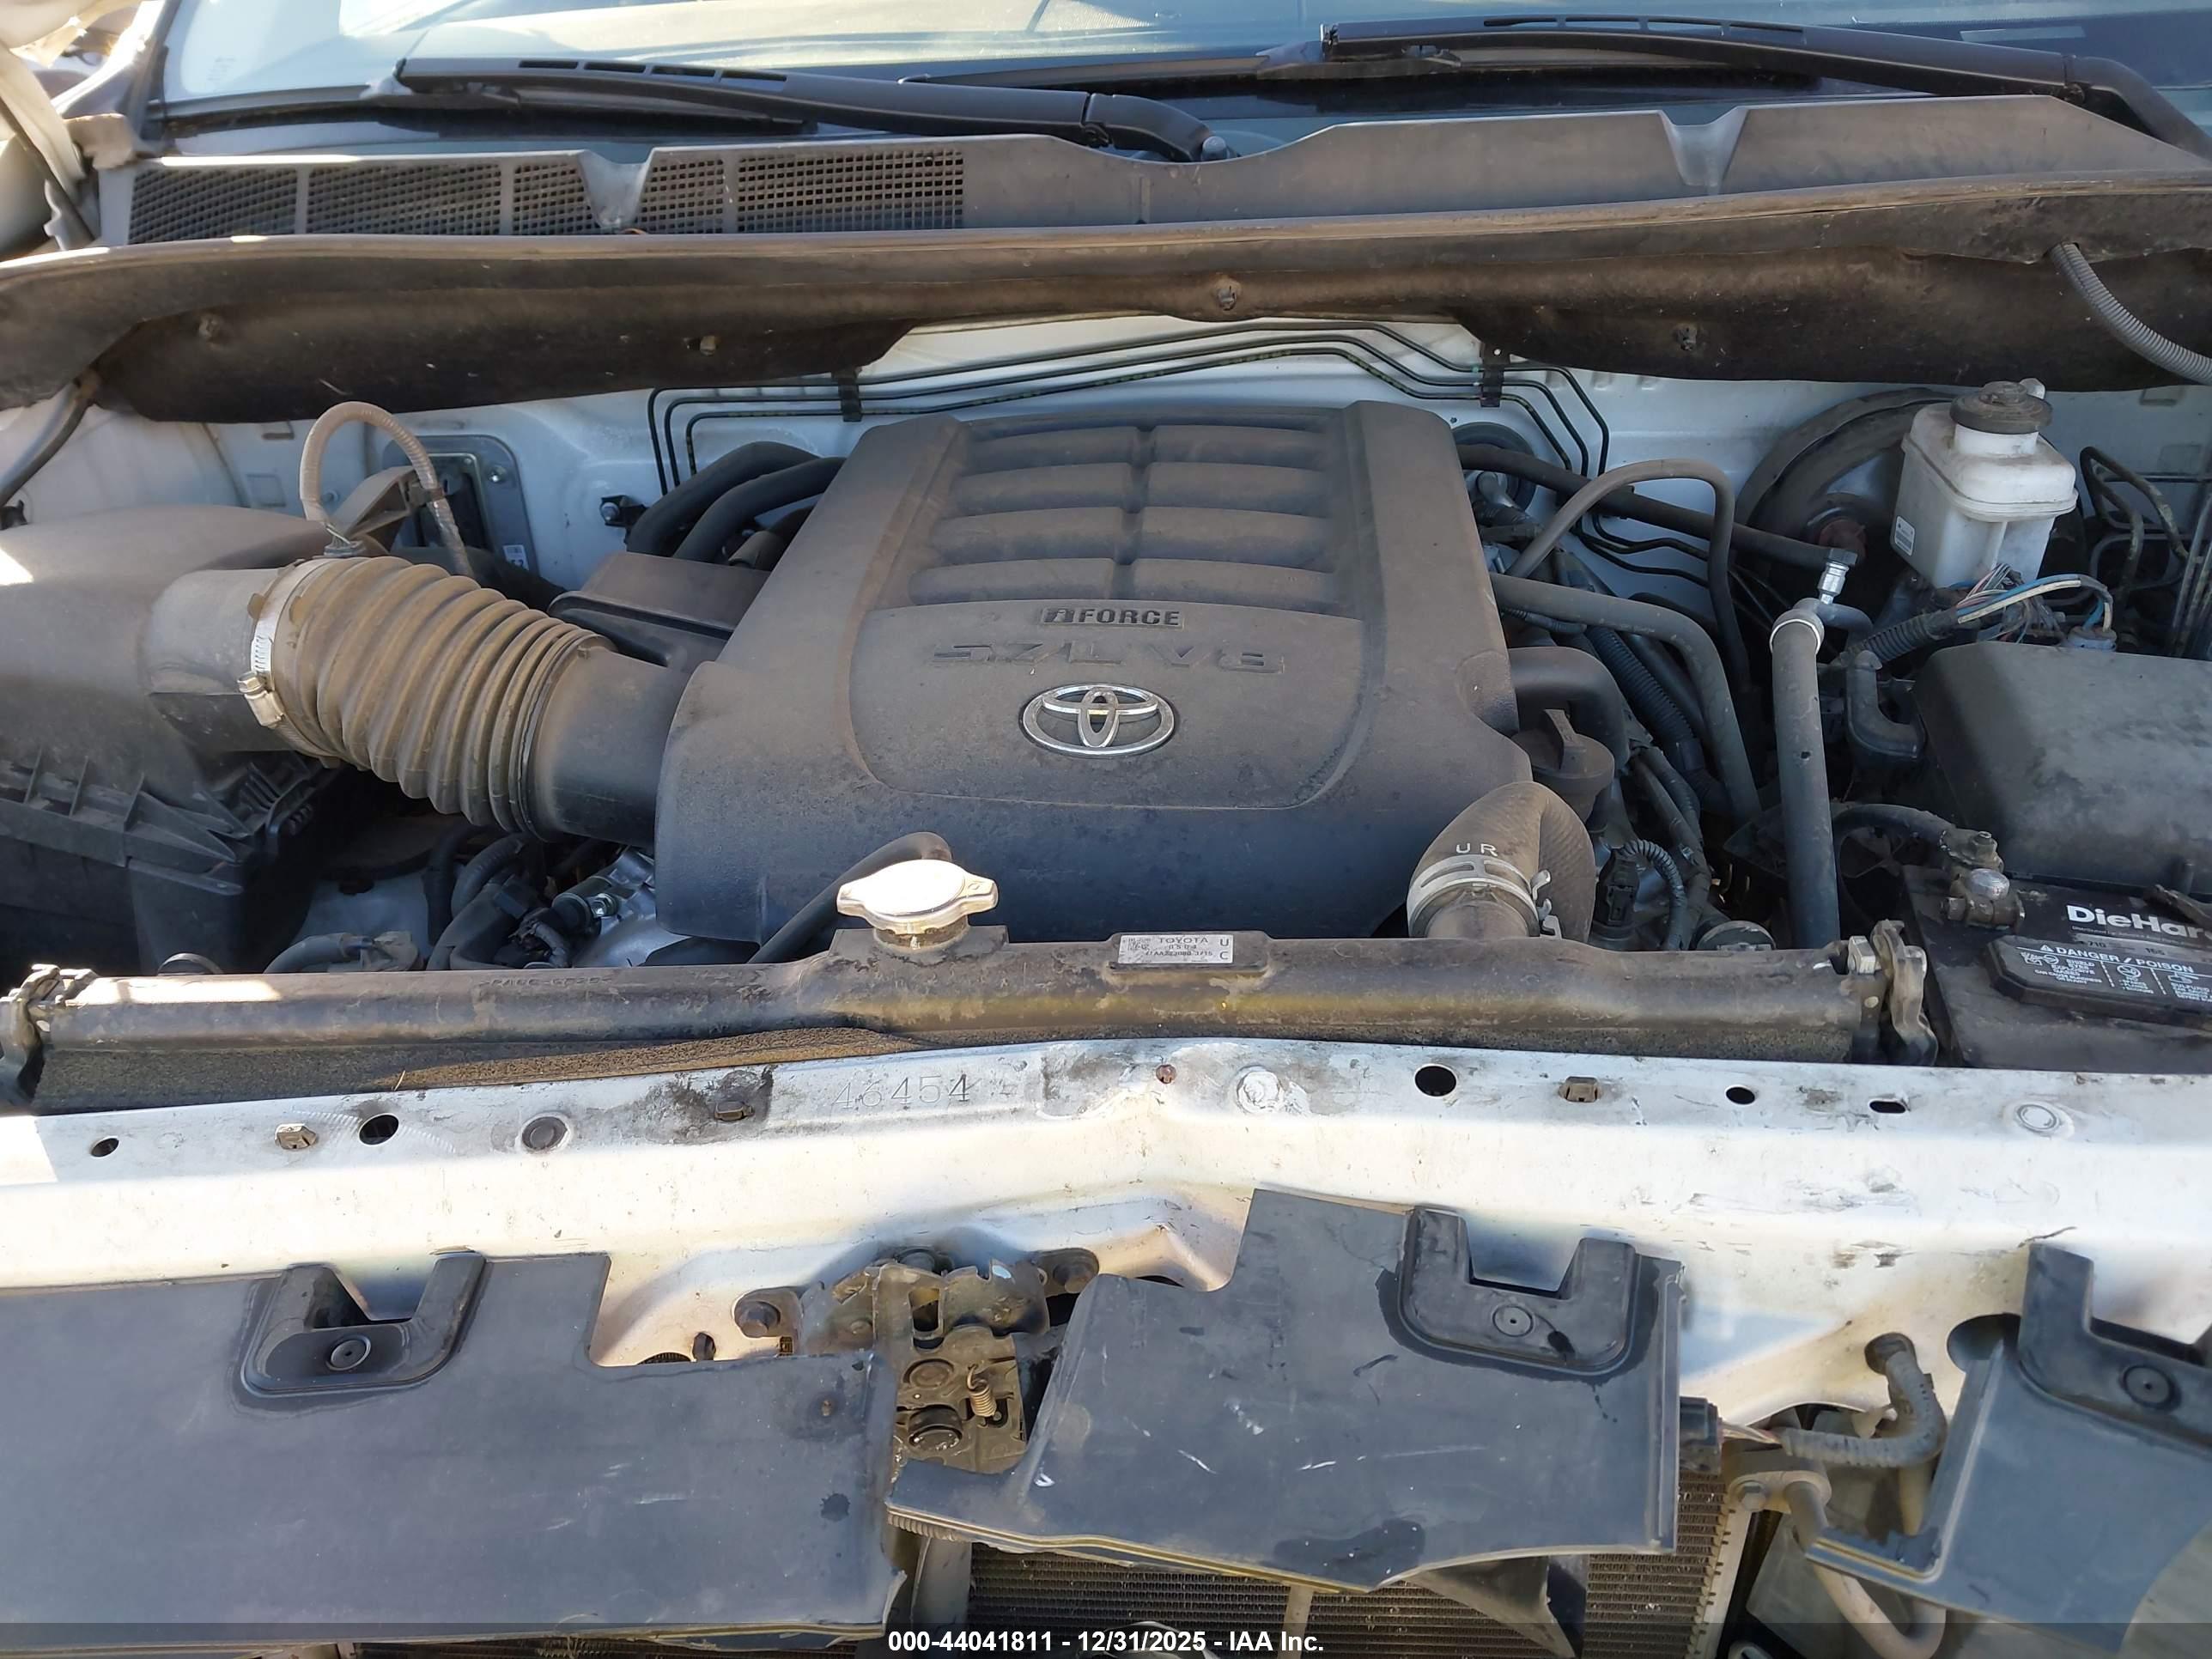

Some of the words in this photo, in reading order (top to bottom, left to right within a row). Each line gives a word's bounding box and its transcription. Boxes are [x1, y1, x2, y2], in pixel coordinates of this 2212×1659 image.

[1455, 842, 1471, 854] U
[1480, 842, 1499, 857] R
[1219, 938, 1230, 947] U
[1219, 951, 1229, 960] C
[2055, 946, 2120, 963] DANGER
[2135, 957, 2195, 973] POISON
[831, 1073, 971, 1109] 46454
